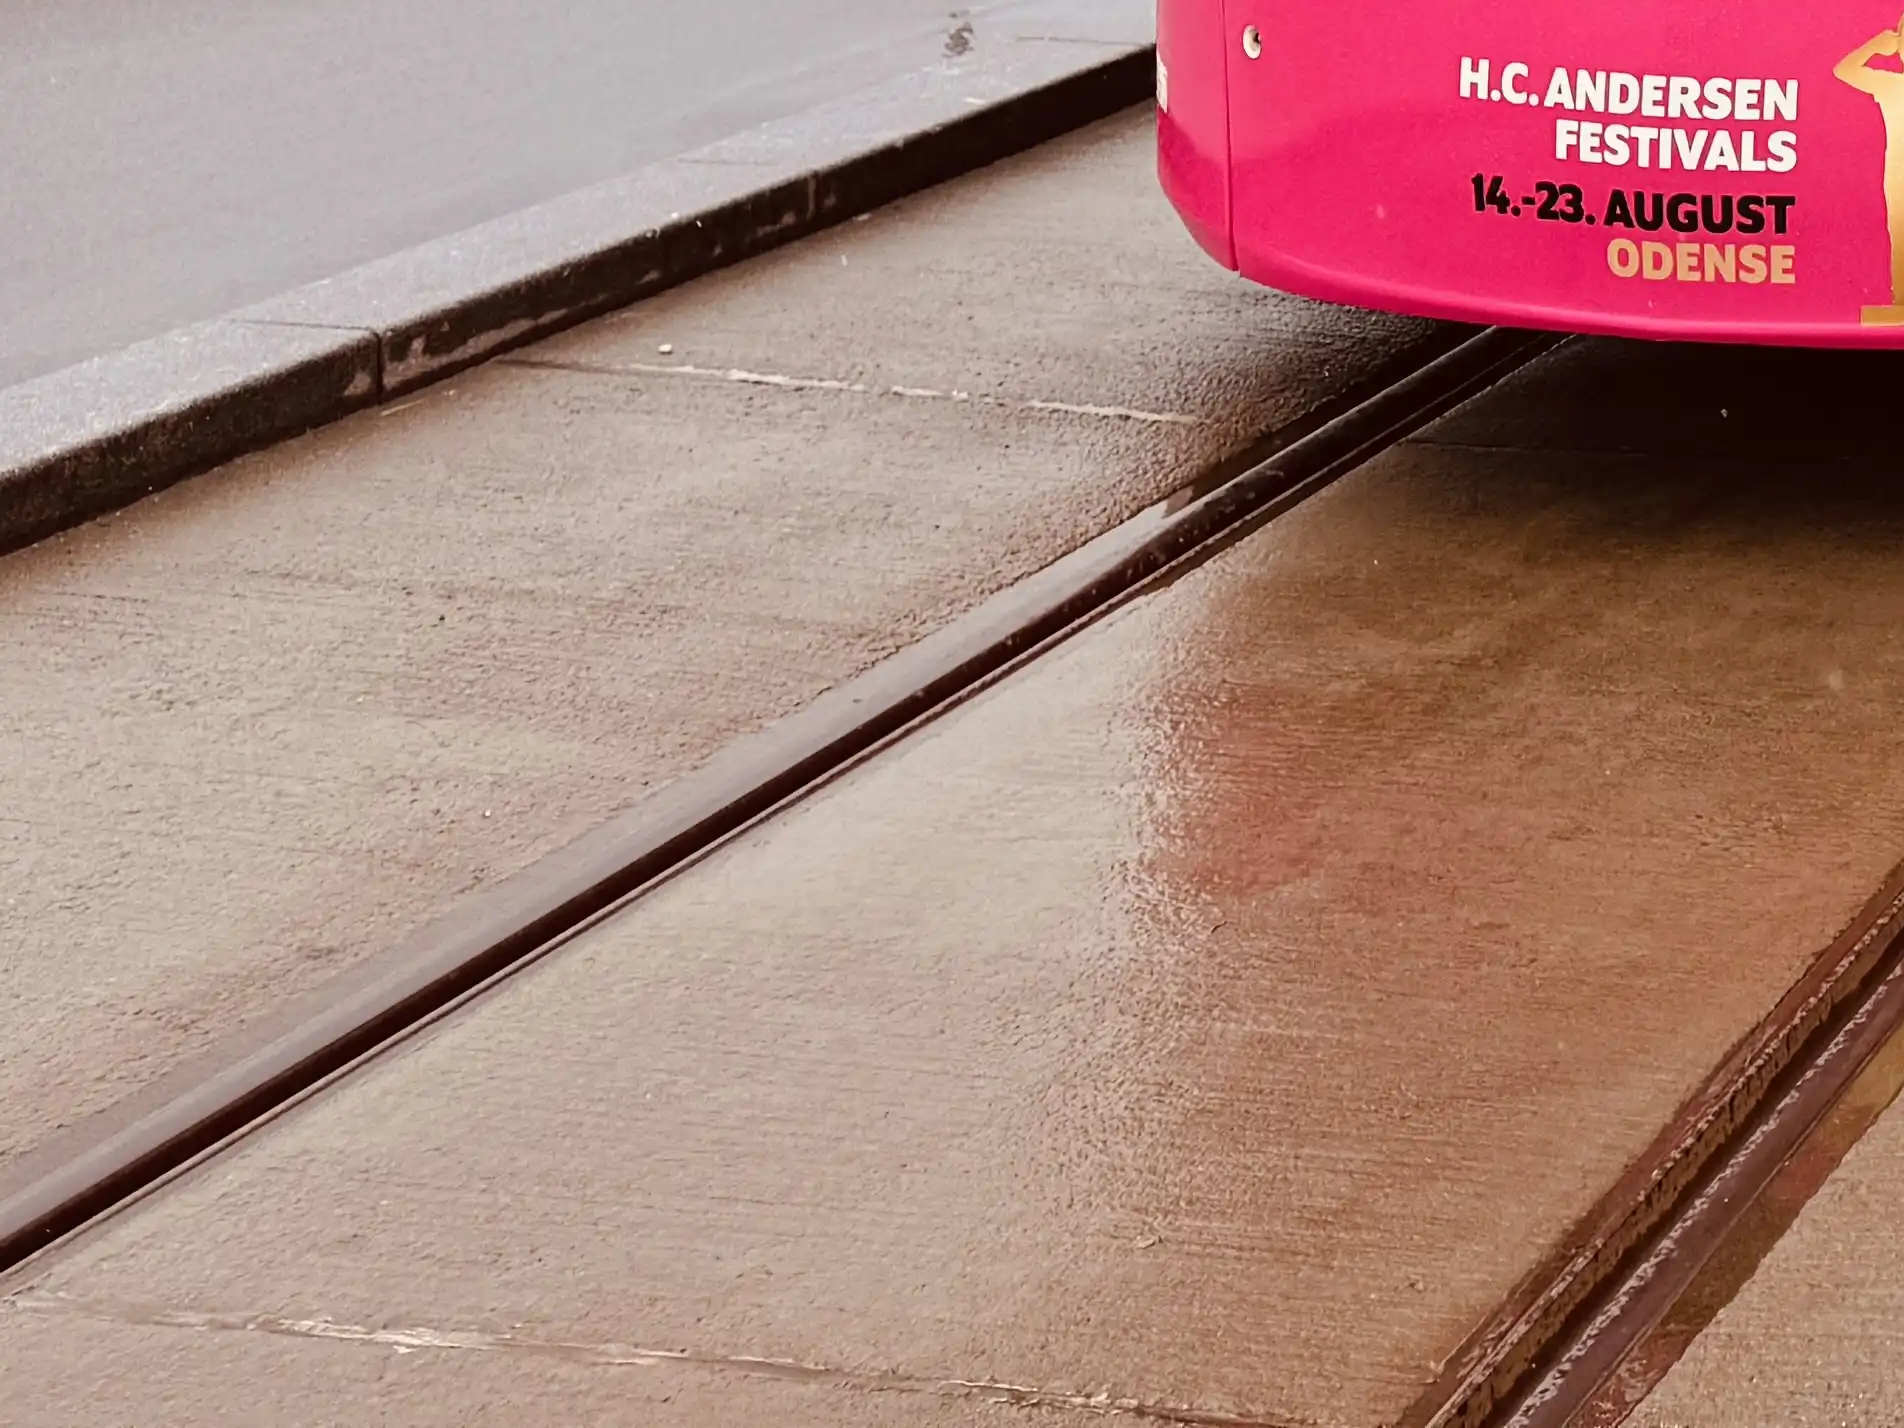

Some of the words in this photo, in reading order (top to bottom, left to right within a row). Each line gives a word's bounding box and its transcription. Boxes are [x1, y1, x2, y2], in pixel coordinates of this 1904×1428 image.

[1459, 56, 1540, 107] H.C.
[1543, 66, 1799, 121] ANDERSEN
[1555, 118, 1798, 173] FESTIVALS
[1471, 172, 1597, 226] 14.-23.
[1603, 188, 1797, 234] AUGUST
[1606, 238, 1797, 285] ODENSE
